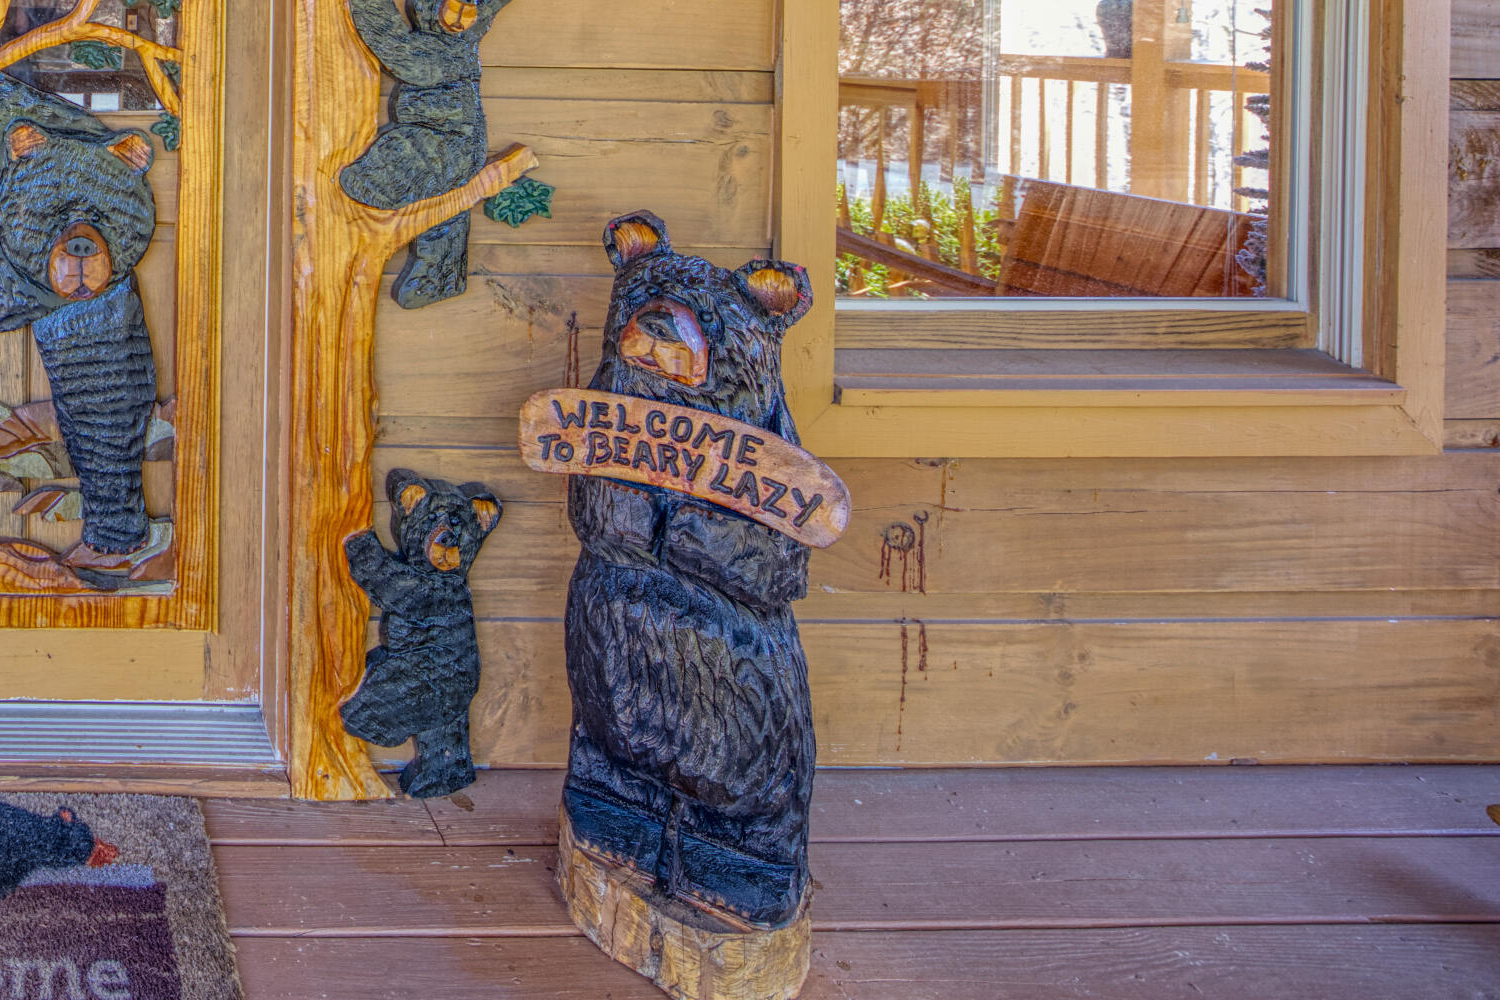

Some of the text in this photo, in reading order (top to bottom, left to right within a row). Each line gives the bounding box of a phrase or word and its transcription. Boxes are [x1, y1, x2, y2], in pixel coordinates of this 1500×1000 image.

[551, 398, 765, 468] WELCOME
[585, 430, 706, 482] BEARY
[708, 462, 825, 529] LAZY
